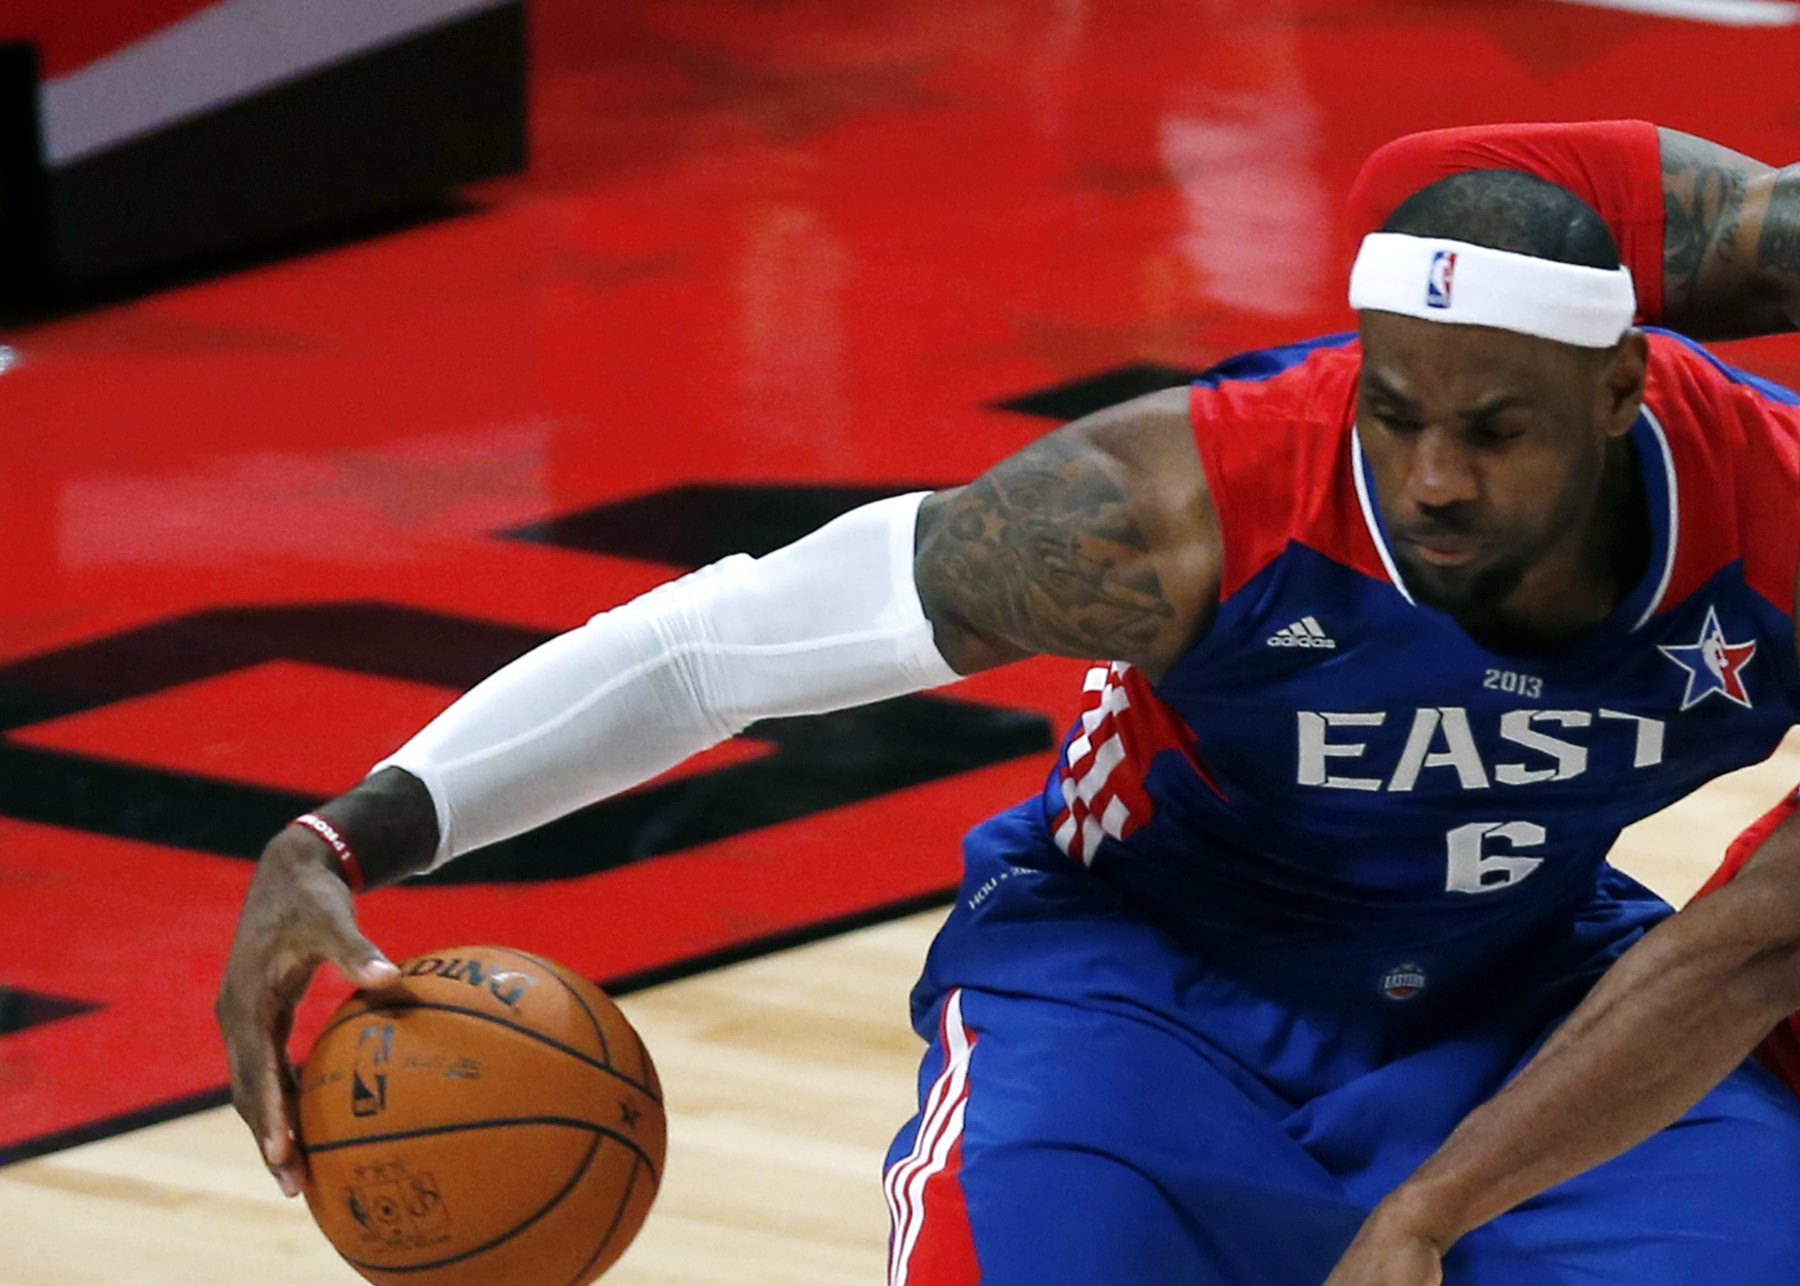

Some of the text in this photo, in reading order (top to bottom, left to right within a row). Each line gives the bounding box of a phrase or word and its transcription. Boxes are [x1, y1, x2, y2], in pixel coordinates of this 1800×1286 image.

[1266, 636, 1336, 648] adidas
[1483, 669, 1543, 699] 2013
[1297, 707, 1665, 792] EAST
[1445, 820, 1546, 894] 6
